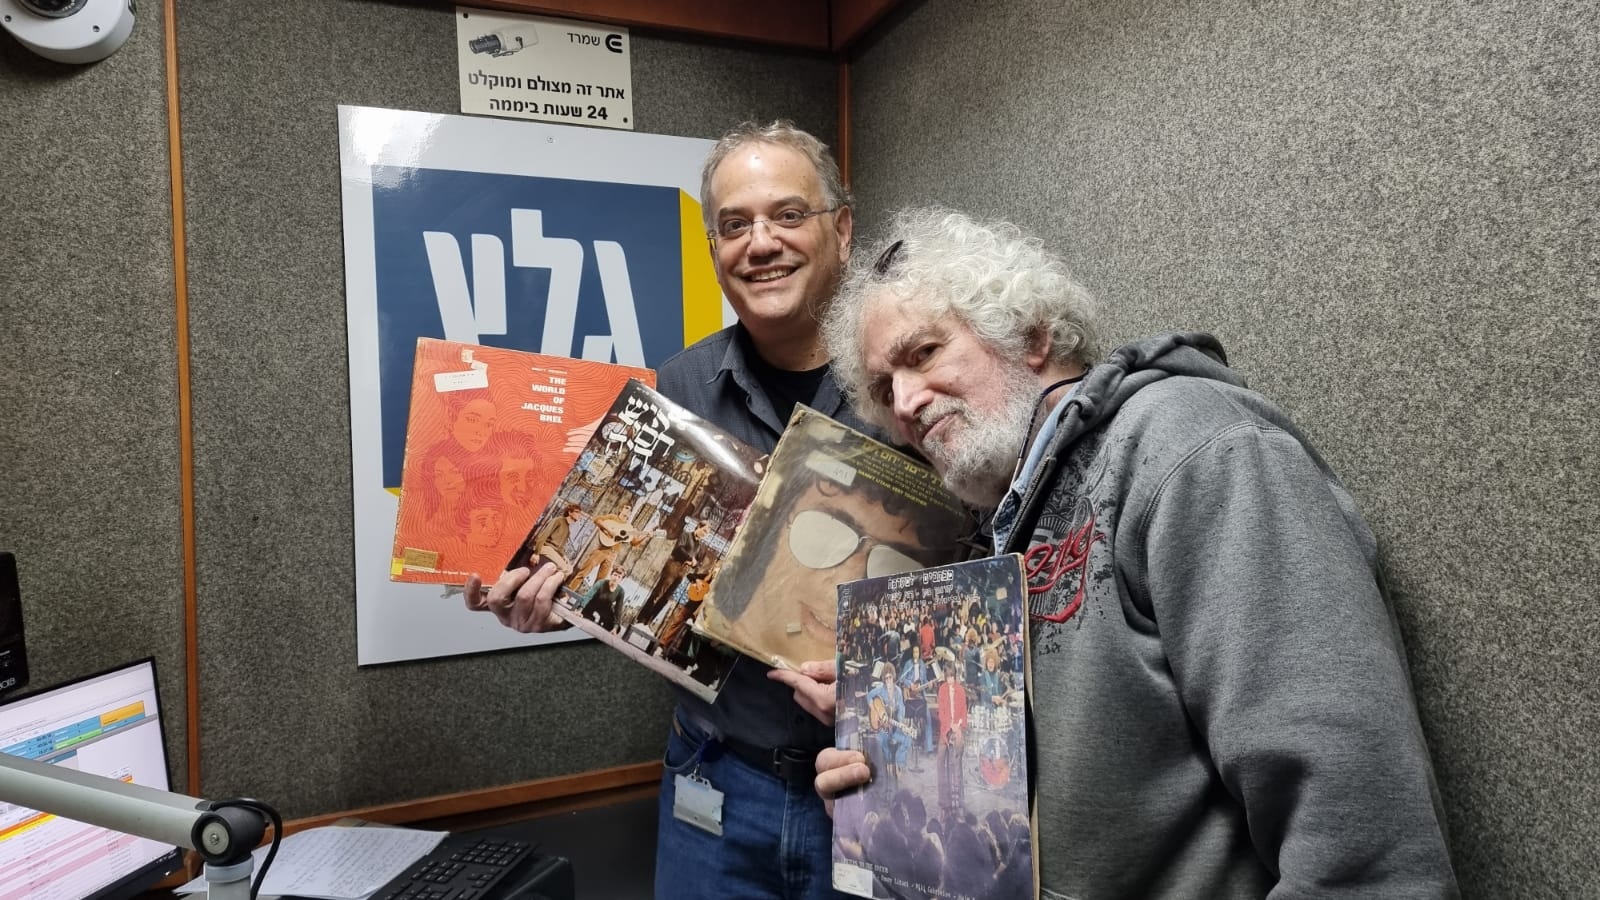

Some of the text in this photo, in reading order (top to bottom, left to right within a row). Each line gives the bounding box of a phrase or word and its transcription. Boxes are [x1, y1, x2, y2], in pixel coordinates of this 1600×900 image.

[567, 32, 600, 46] שמרד
[468, 70, 625, 100] אתר זה מצולם ומוקלט
[489, 98, 608, 120] 24 שעות ביממה
[549, 376, 567, 386] THE
[531, 383, 566, 395] WORLD
[553, 396, 565, 404] OF
[521, 402, 564, 414] JACQUES
[539, 414, 563, 424] BREL
